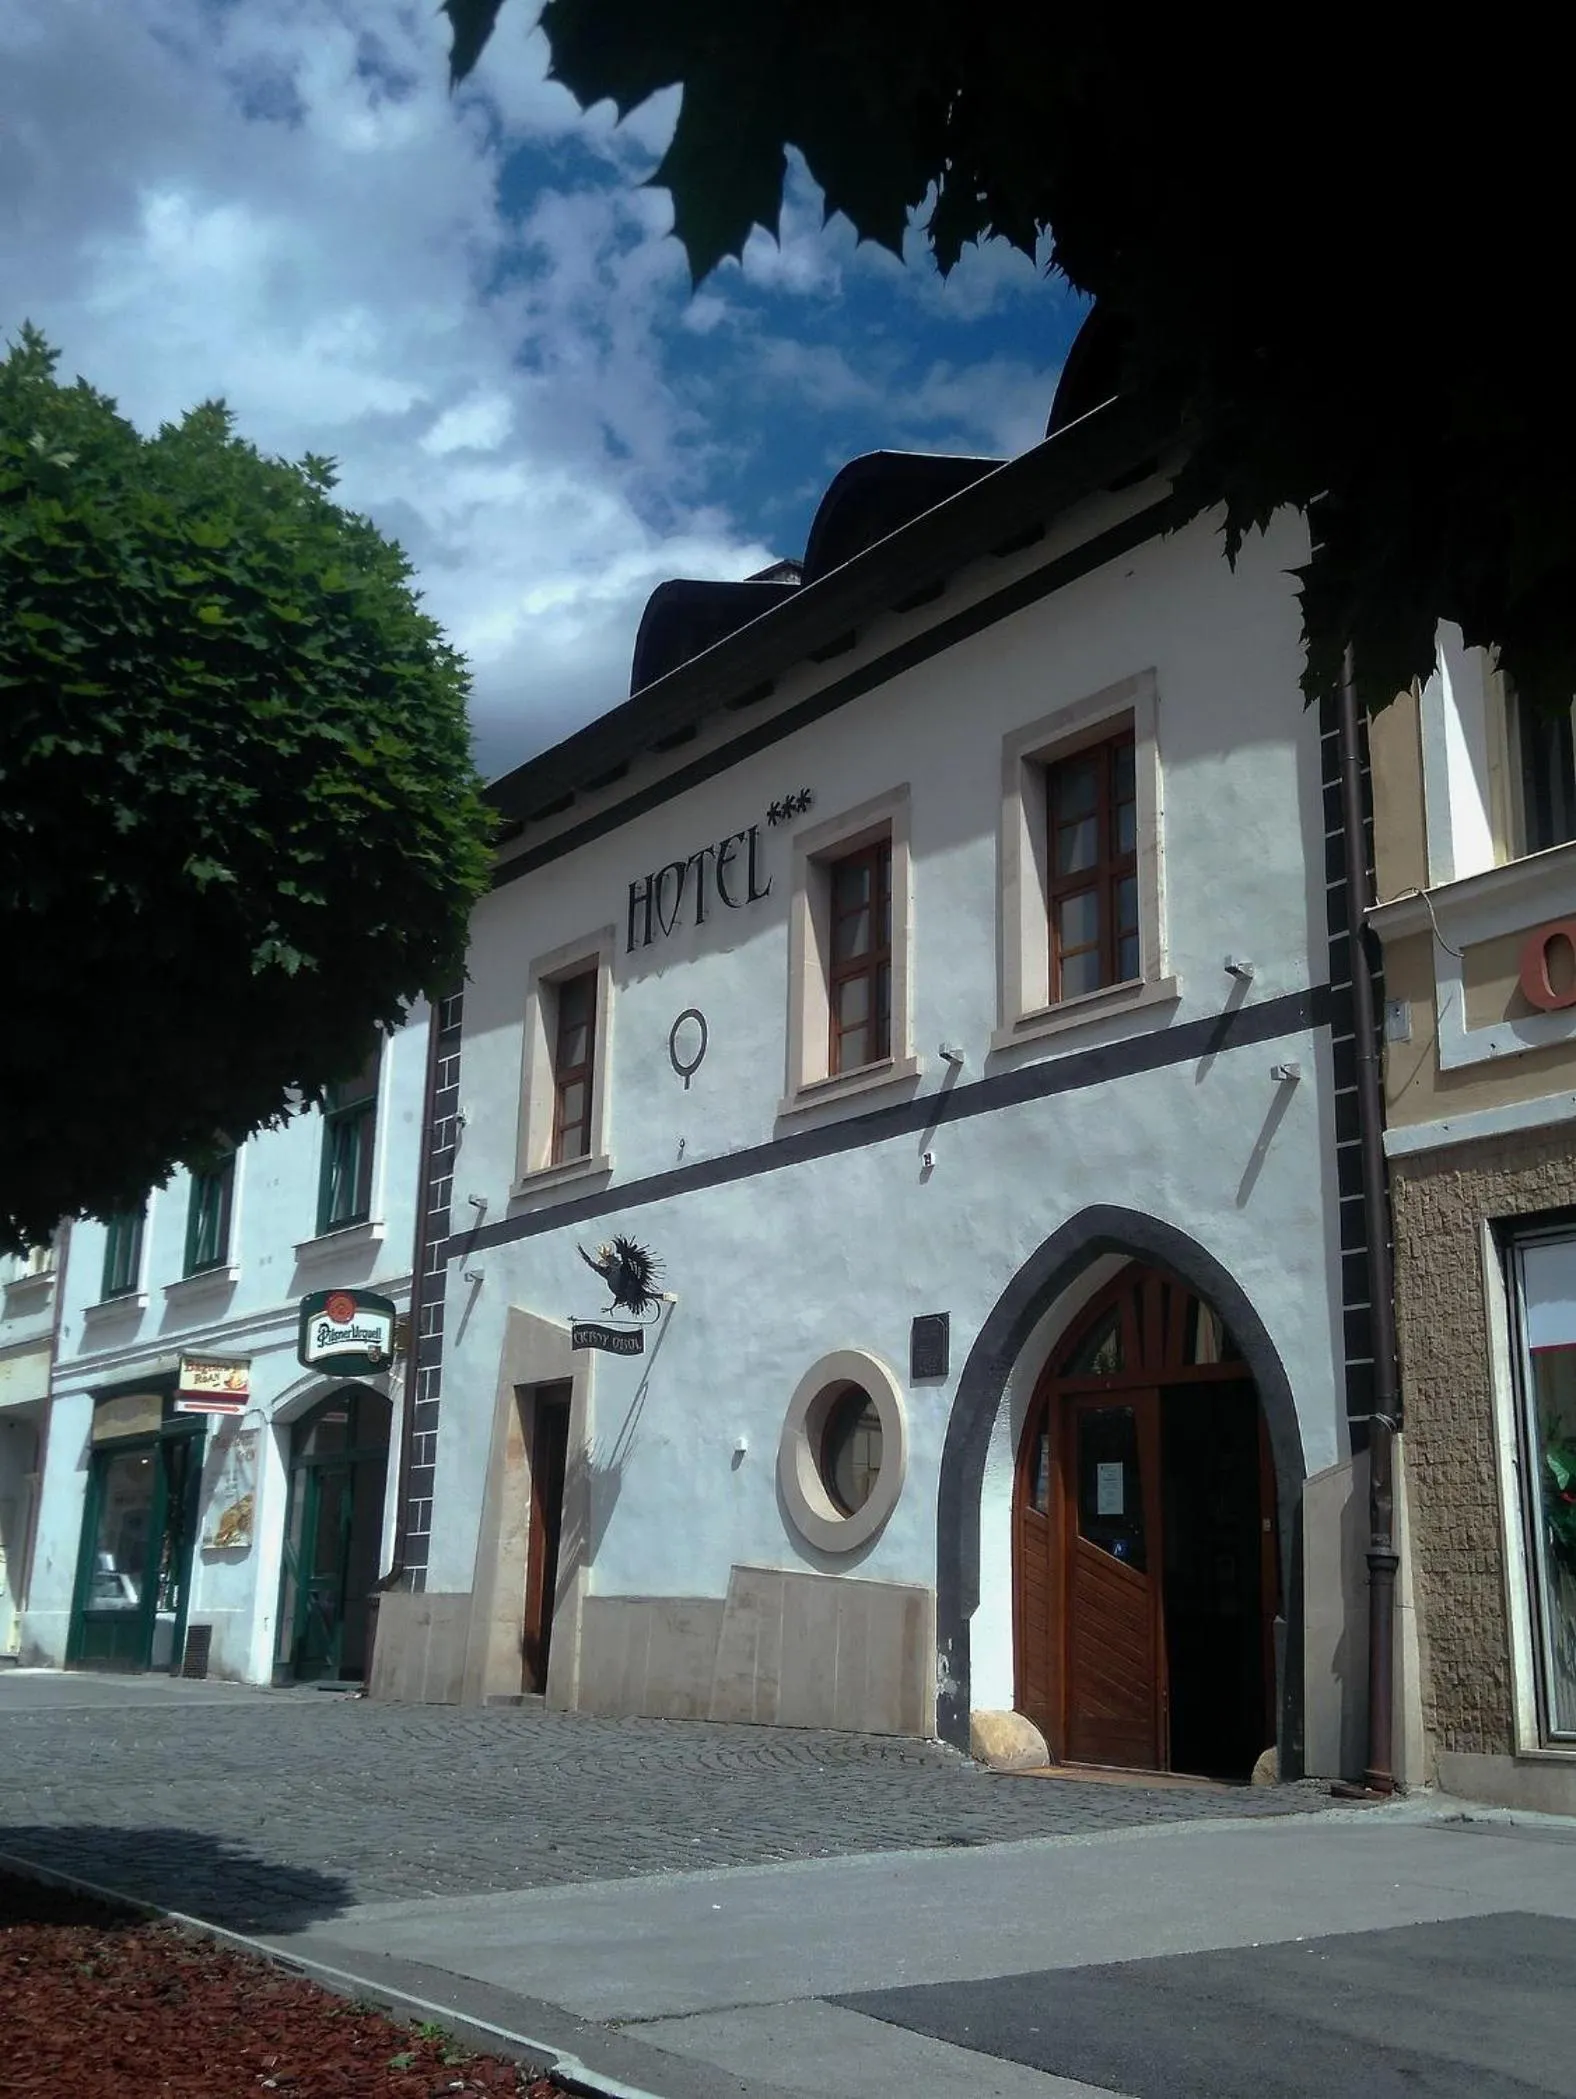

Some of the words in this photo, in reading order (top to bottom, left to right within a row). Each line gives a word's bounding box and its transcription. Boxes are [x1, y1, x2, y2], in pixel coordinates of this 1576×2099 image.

[626, 824, 773, 953] HOTEL
[317, 1322, 352, 1348] Pilsner
[351, 1324, 382, 1343] Urquell
